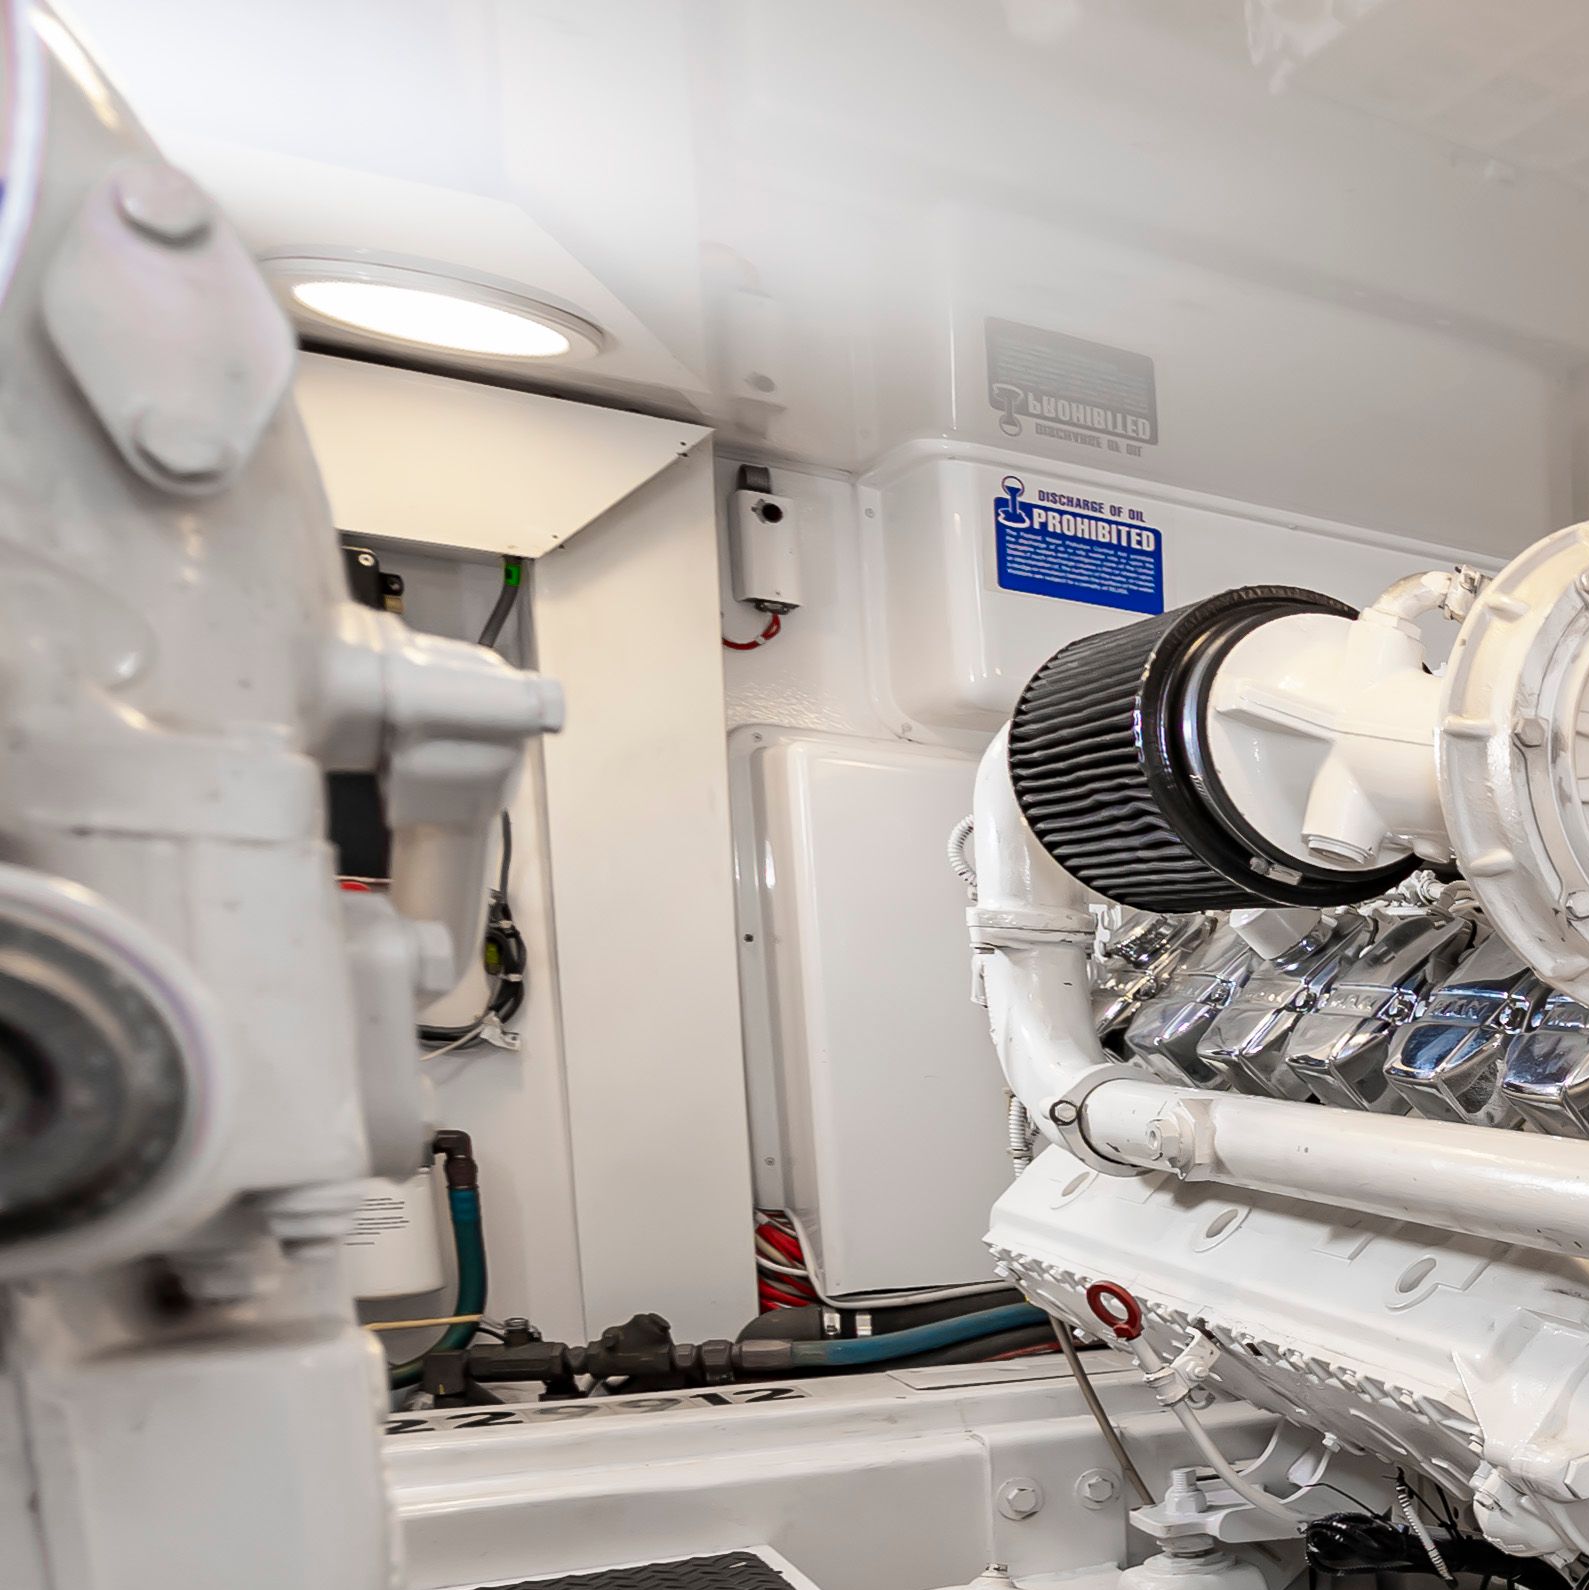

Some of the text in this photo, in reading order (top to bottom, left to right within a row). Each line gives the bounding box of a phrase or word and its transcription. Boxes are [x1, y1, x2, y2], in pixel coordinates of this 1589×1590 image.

[1038, 489, 1146, 523] DISCHARGE OF OIL
[1032, 508, 1156, 552] PROHIBITED
